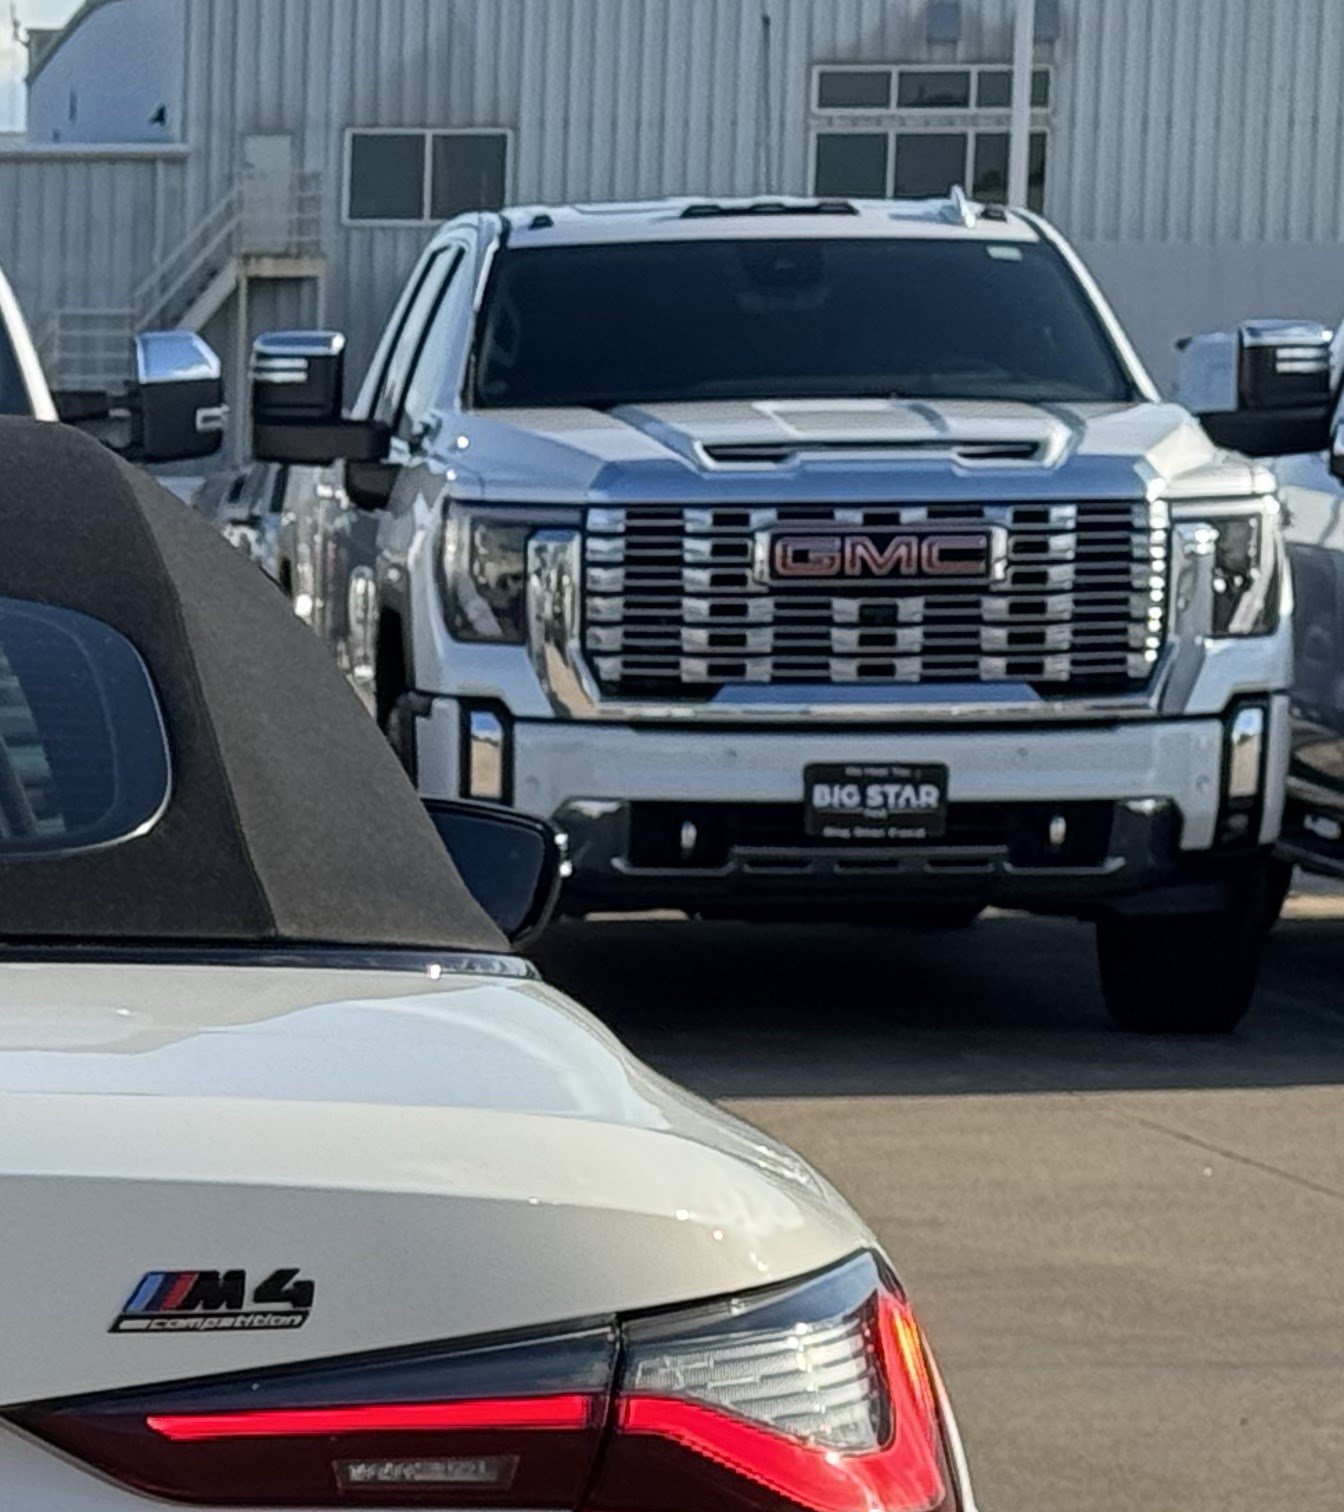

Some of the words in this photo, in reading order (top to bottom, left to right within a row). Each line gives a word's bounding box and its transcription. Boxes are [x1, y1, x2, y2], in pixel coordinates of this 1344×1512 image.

[775, 535, 988, 576] GMC
[813, 783, 861, 808] BIG
[865, 783, 940, 809] STAR
[178, 1268, 315, 1311] M4
[148, 1311, 303, 1331] competition
